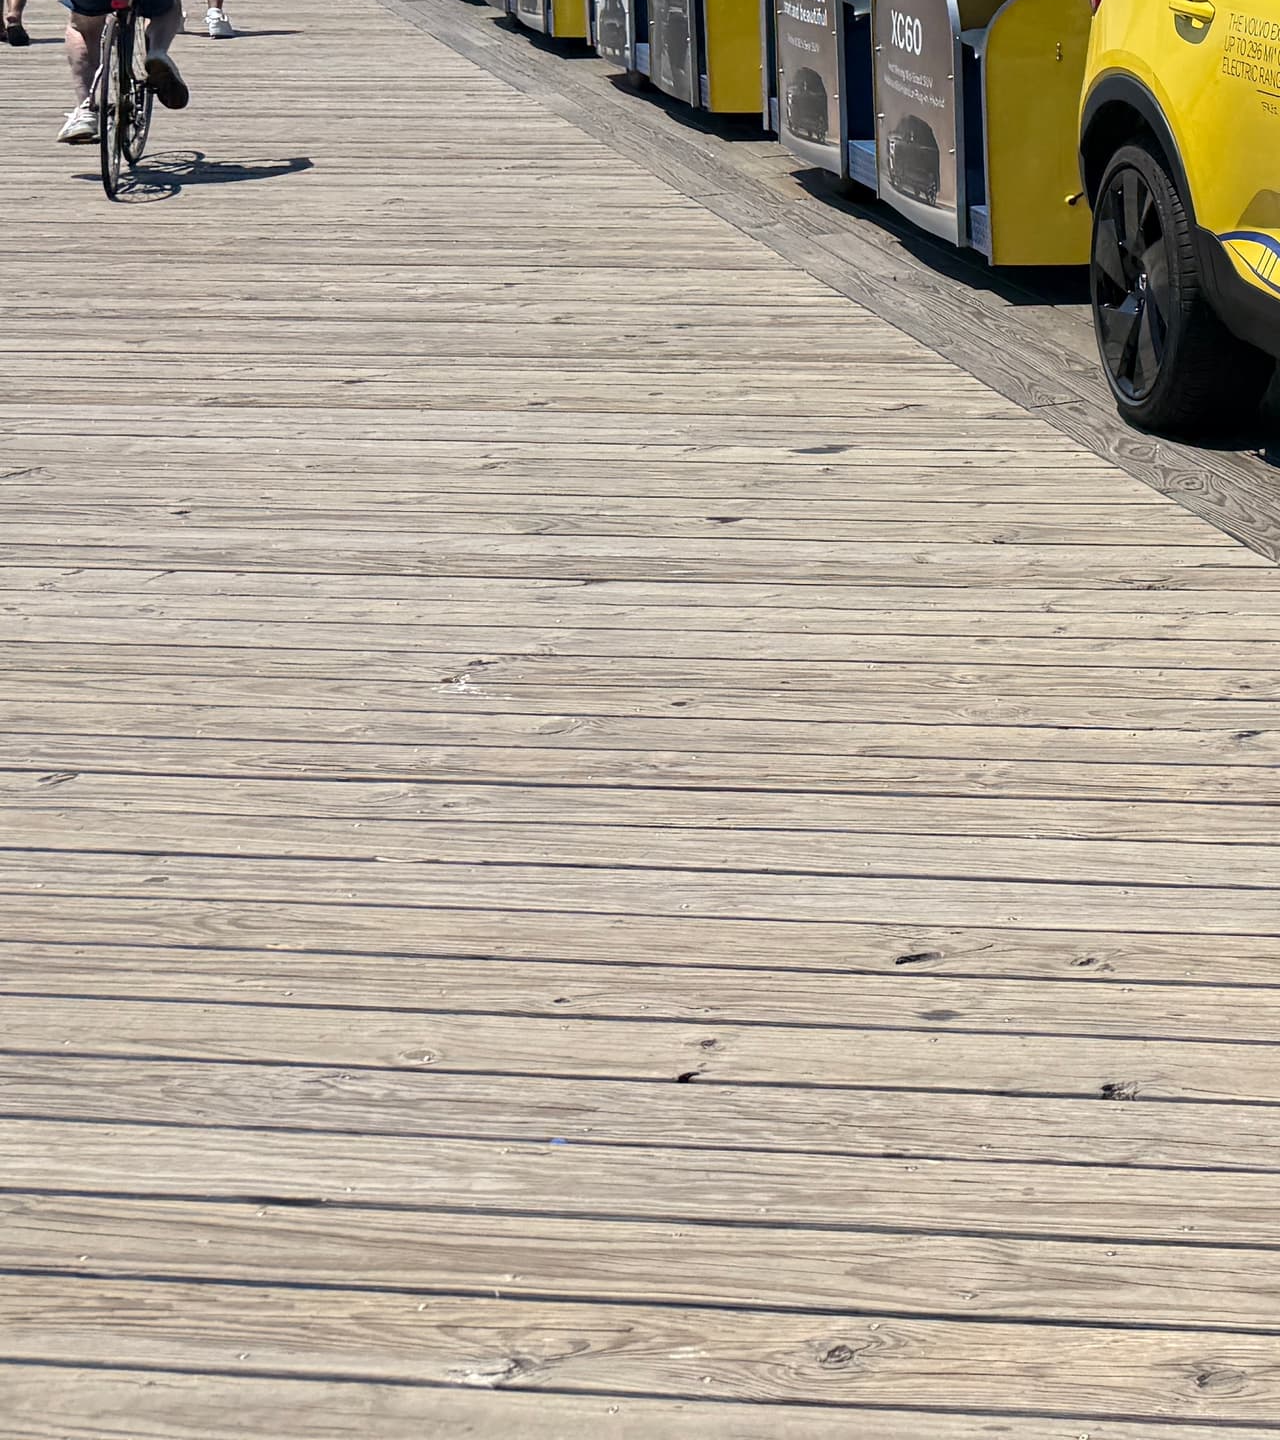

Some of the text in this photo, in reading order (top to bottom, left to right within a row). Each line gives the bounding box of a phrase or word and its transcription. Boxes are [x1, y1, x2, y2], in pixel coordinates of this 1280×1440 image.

[891, 9, 923, 56] XC60
[1229, 13, 1244, 33] THE
[1244, 16, 1270, 39] VOLVO
[1224, 35, 1236, 53] UP
[1236, 37, 1247, 56] TO
[1222, 56, 1258, 82] ELECTRIC
